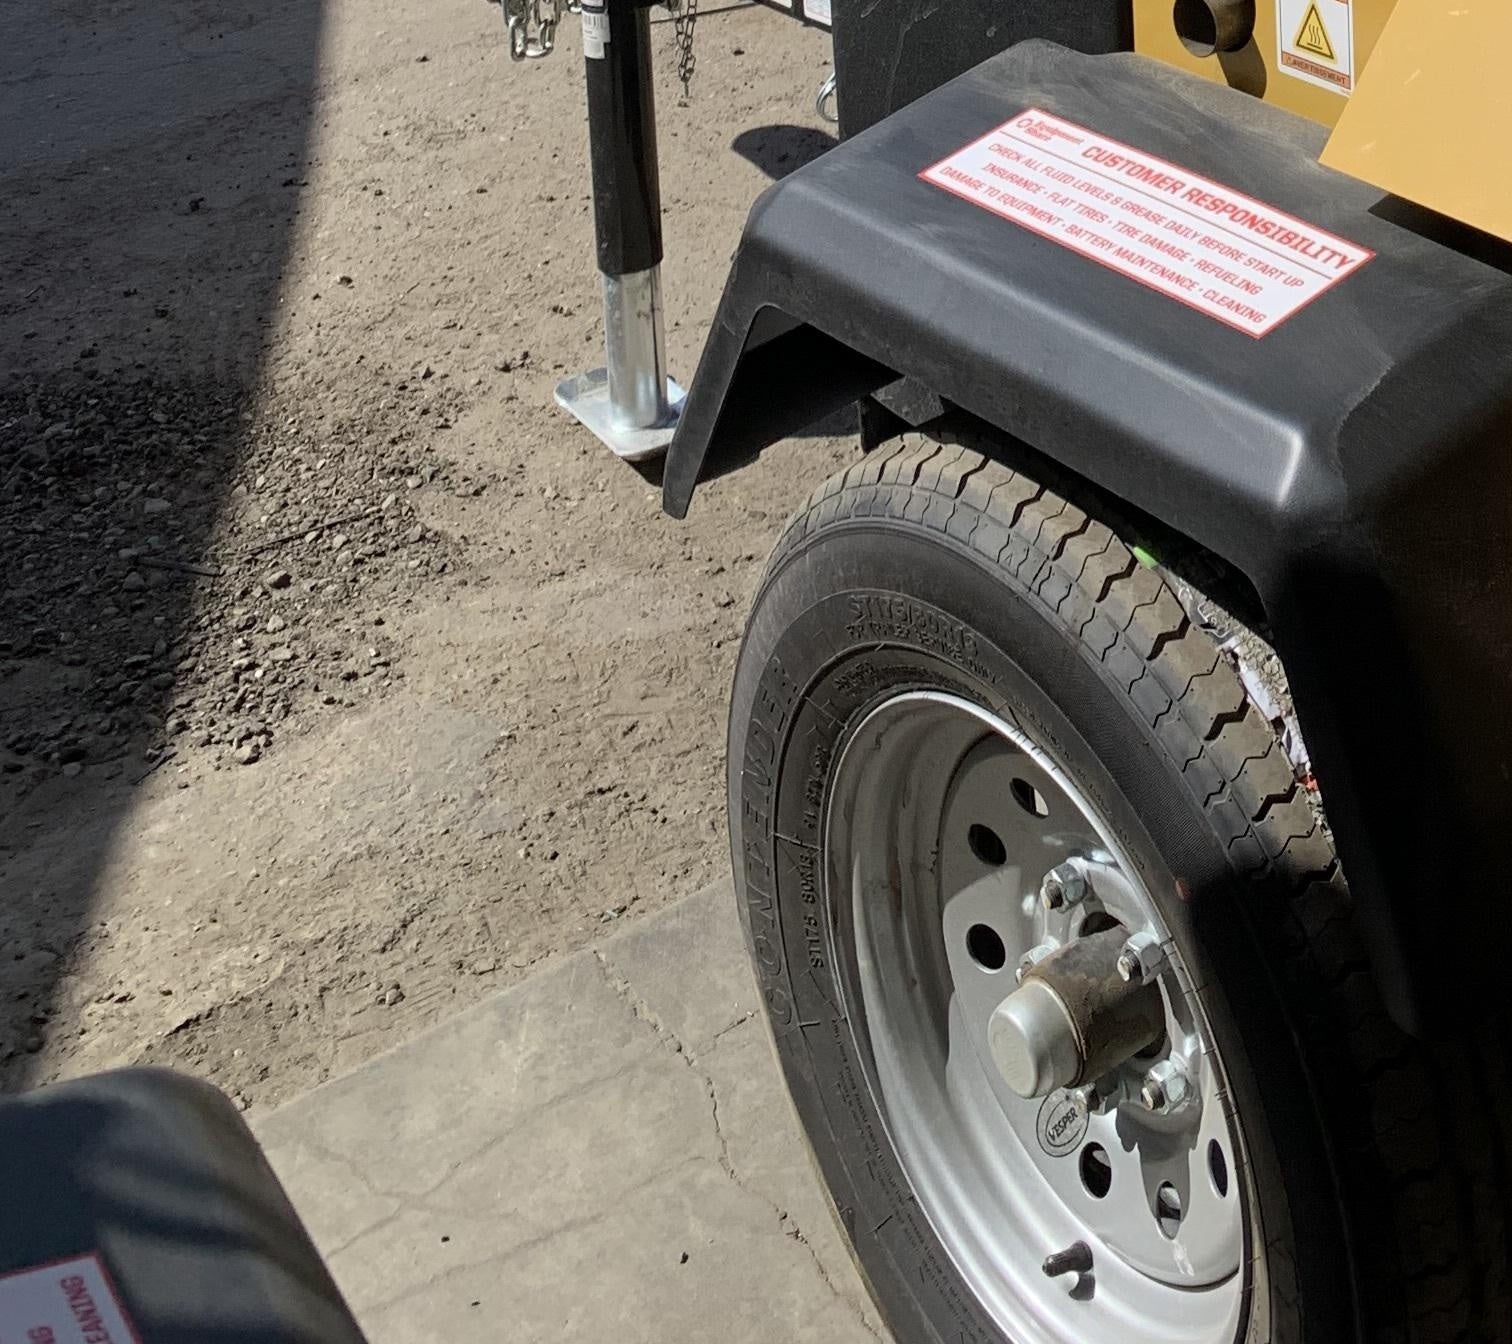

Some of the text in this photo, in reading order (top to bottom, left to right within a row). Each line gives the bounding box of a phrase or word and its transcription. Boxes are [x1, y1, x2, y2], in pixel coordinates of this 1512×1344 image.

[940, 166, 1267, 324] DAMAGE TO EQUIPMENT BATTERY MAINTENANCE CLEANING
[982, 162, 1042, 194] INSURANCE
[1047, 190, 1076, 209] FLAT
[1074, 203, 1107, 224] TIRES
[1139, 233, 1190, 262] DAMAGE
[1194, 258, 1264, 296] REFUELING
[988, 143, 1025, 162] CHECK
[1023, 159, 1043, 172] ALL
[1042, 166, 1075, 185] FLUID
[1072, 179, 1111, 202] LEVELS
[1120, 199, 1167, 226] GREASE
[1164, 220, 1201, 241] DAILY
[1198, 235, 1248, 263] BEFORE
[1243, 255, 1288, 283] START
[1283, 273, 1305, 289] UP
[1081, 145, 1356, 269] CUSTOMER RESPONSIBILITY
[1047, 1106, 1079, 1142] VESPER
